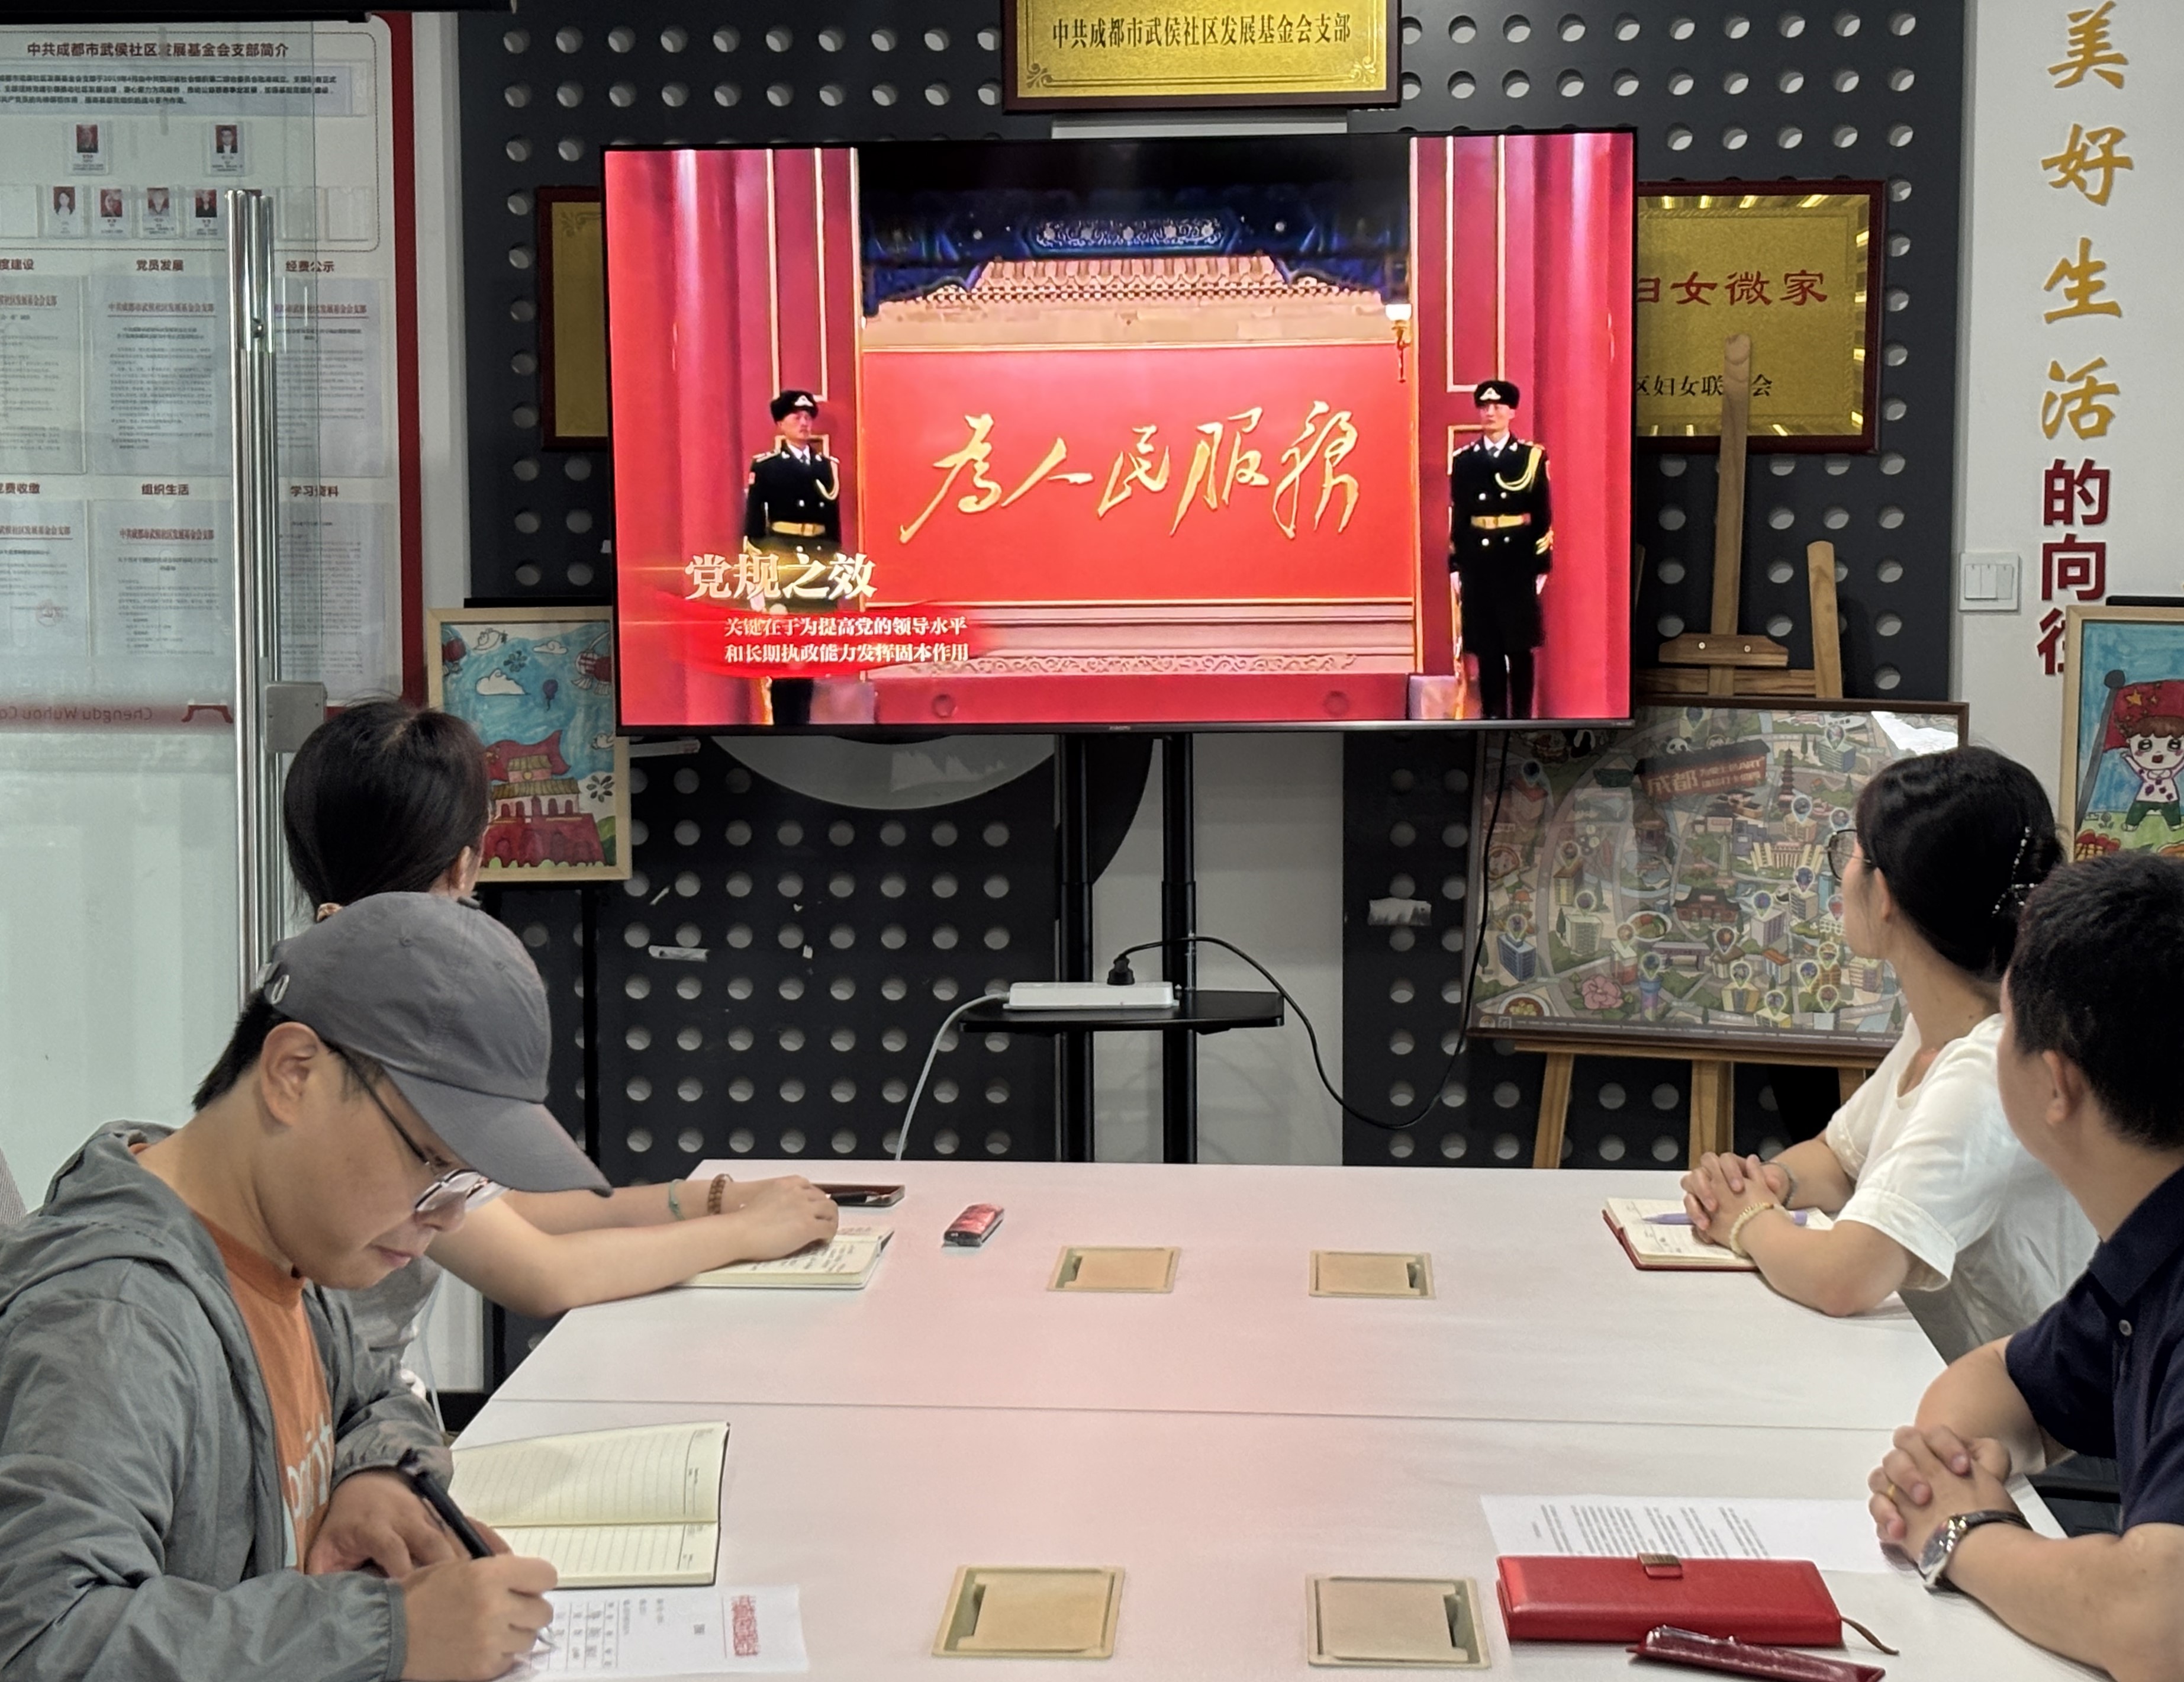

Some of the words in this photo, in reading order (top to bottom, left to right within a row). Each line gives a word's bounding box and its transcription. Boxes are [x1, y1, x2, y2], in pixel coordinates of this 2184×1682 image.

[1052, 12, 1351, 49] 中共成都市武侯社区发展基金会支部
[27, 42, 289, 58] 中共成都市武侯社区发展基金会支部简介
[136, 259, 184, 272] 党员发展
[285, 260, 334, 273] 经费公示
[1637, 373, 1773, 398] 区妇女联会
[141, 483, 189, 496] 组织生活
[290, 484, 339, 497] 学习资料
[684, 552, 878, 600] 党规之效
[724, 616, 968, 638] 关键在于为提高党的领导水平
[723, 642, 969, 663] 和长期执政能力发挥固本作用
